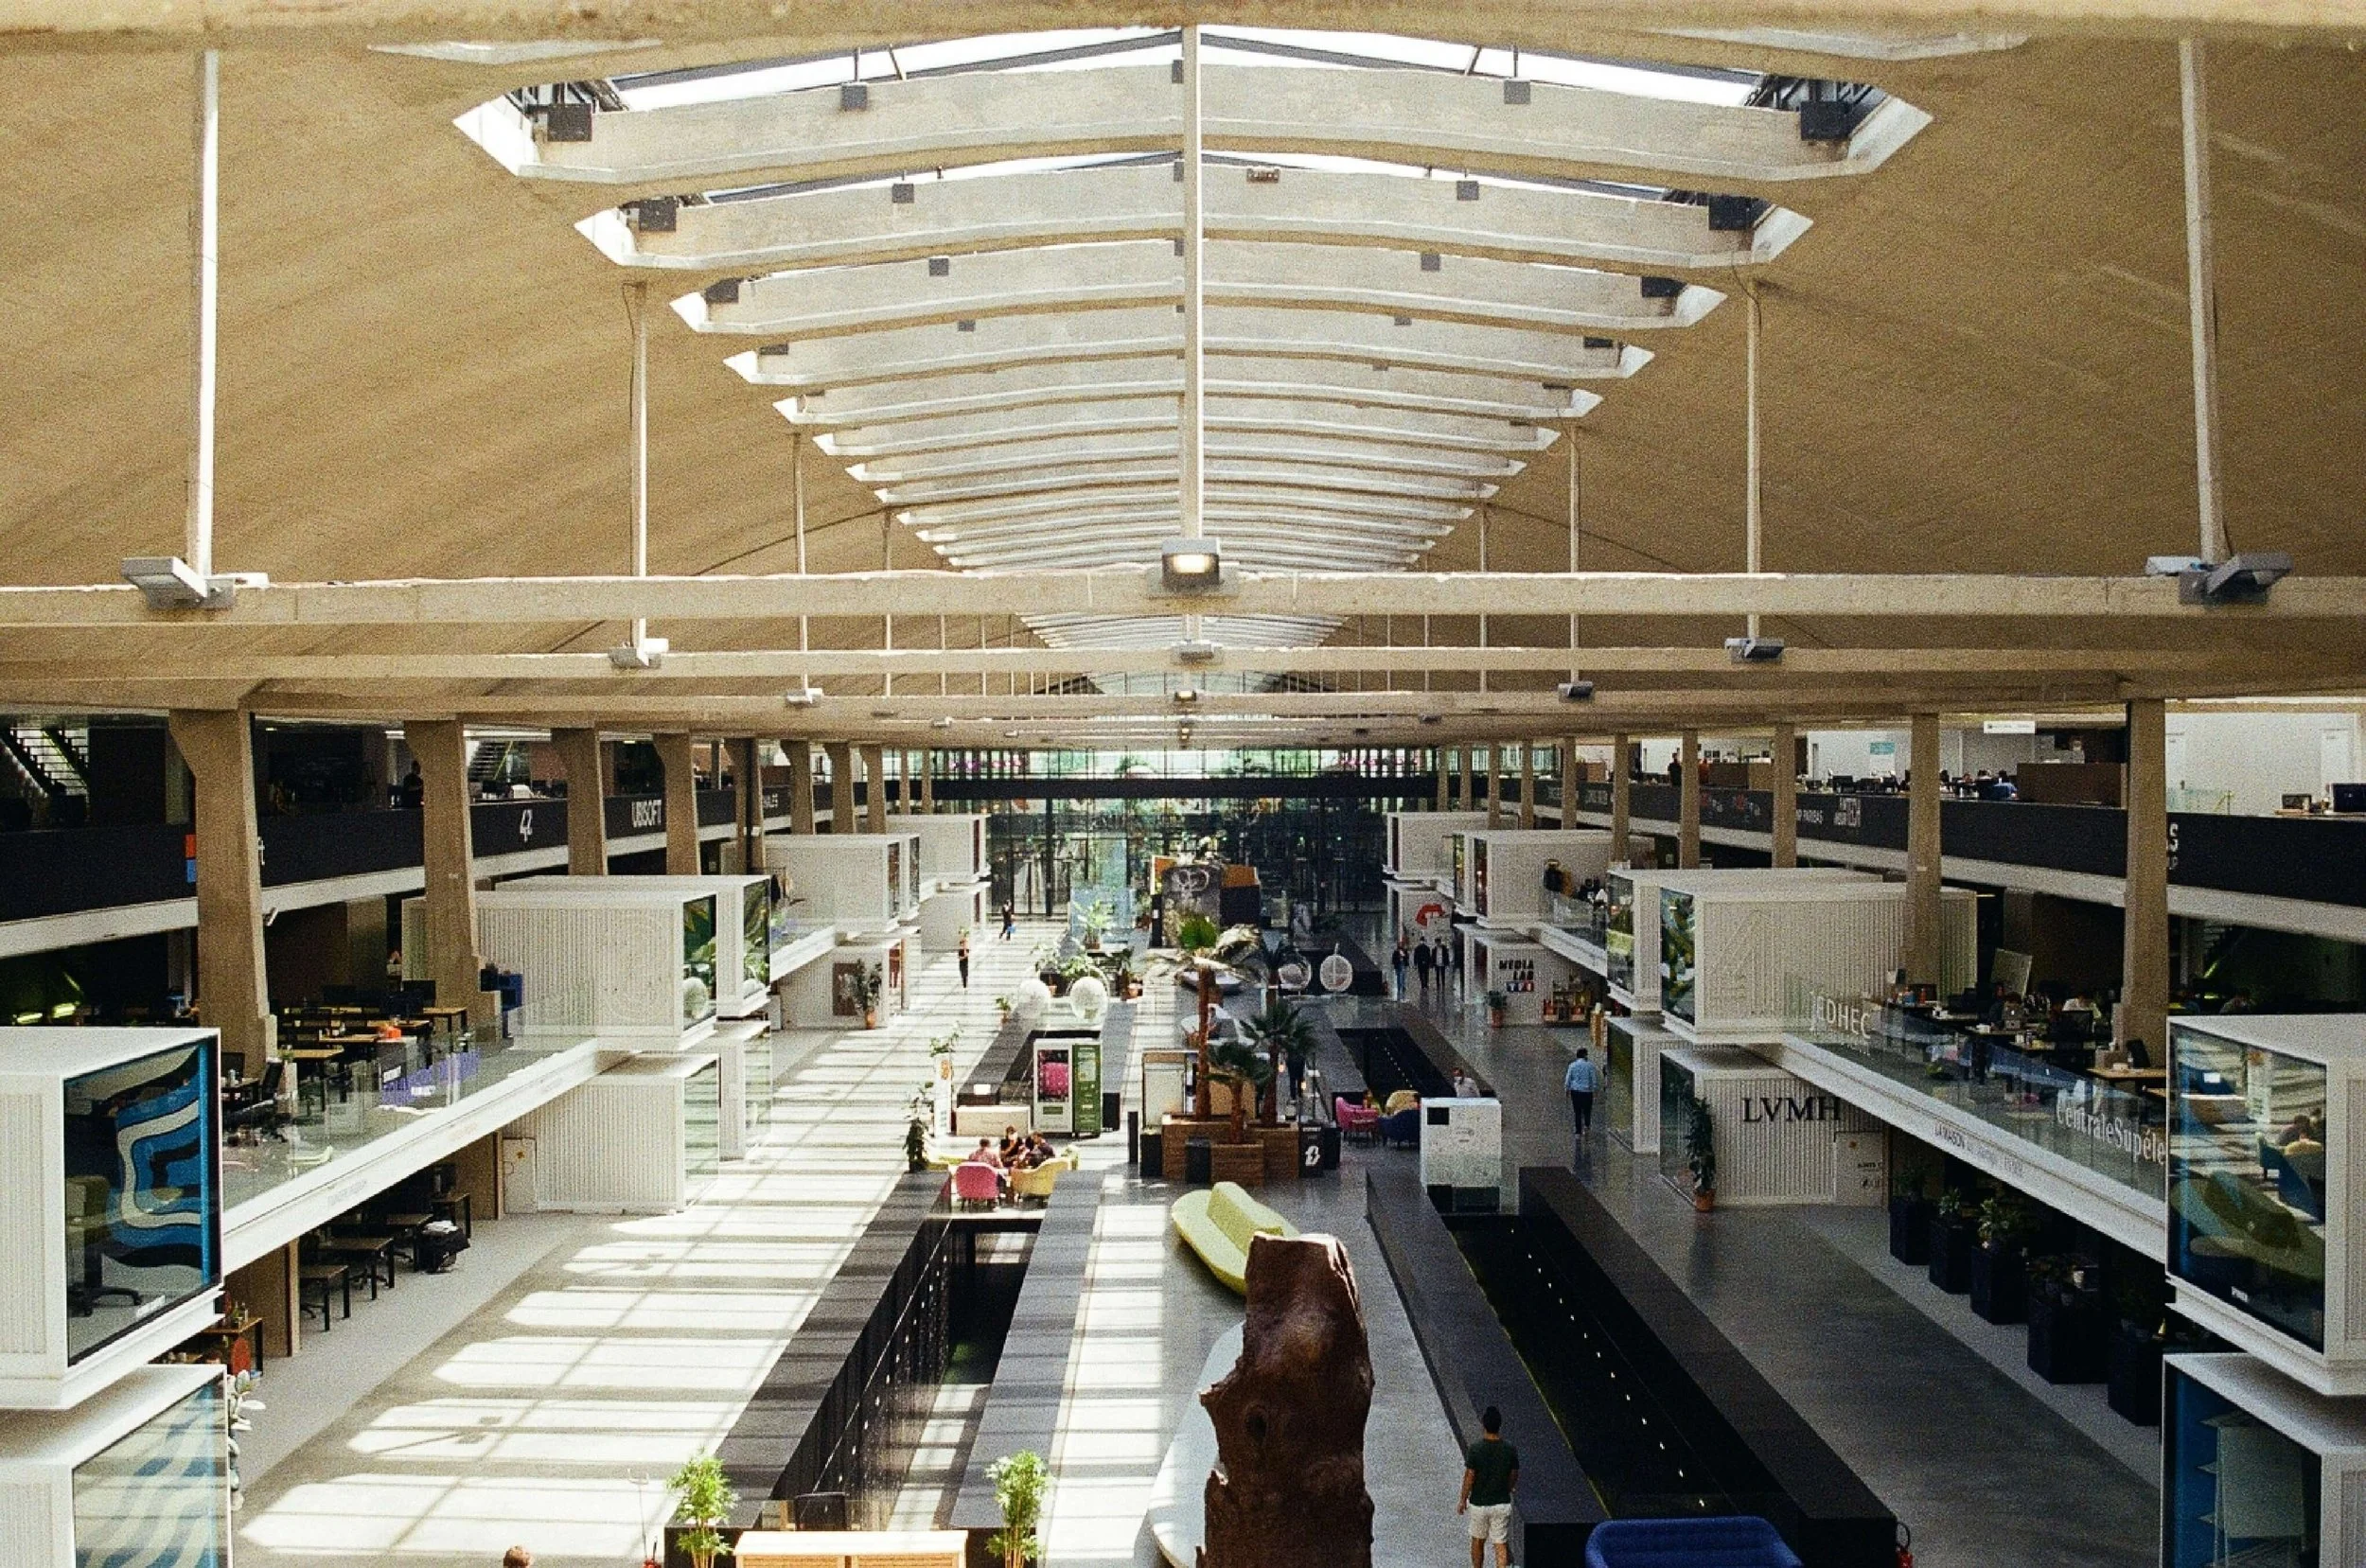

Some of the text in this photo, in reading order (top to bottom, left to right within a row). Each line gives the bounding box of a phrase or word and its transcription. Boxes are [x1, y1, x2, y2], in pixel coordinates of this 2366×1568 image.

[1499, 960, 1534, 970] MEDIA
[1513, 970, 1534, 980] LAB
[1742, 1096, 1841, 1122] LVMH
[2056, 1091, 2167, 1166] CentraleSupéle
